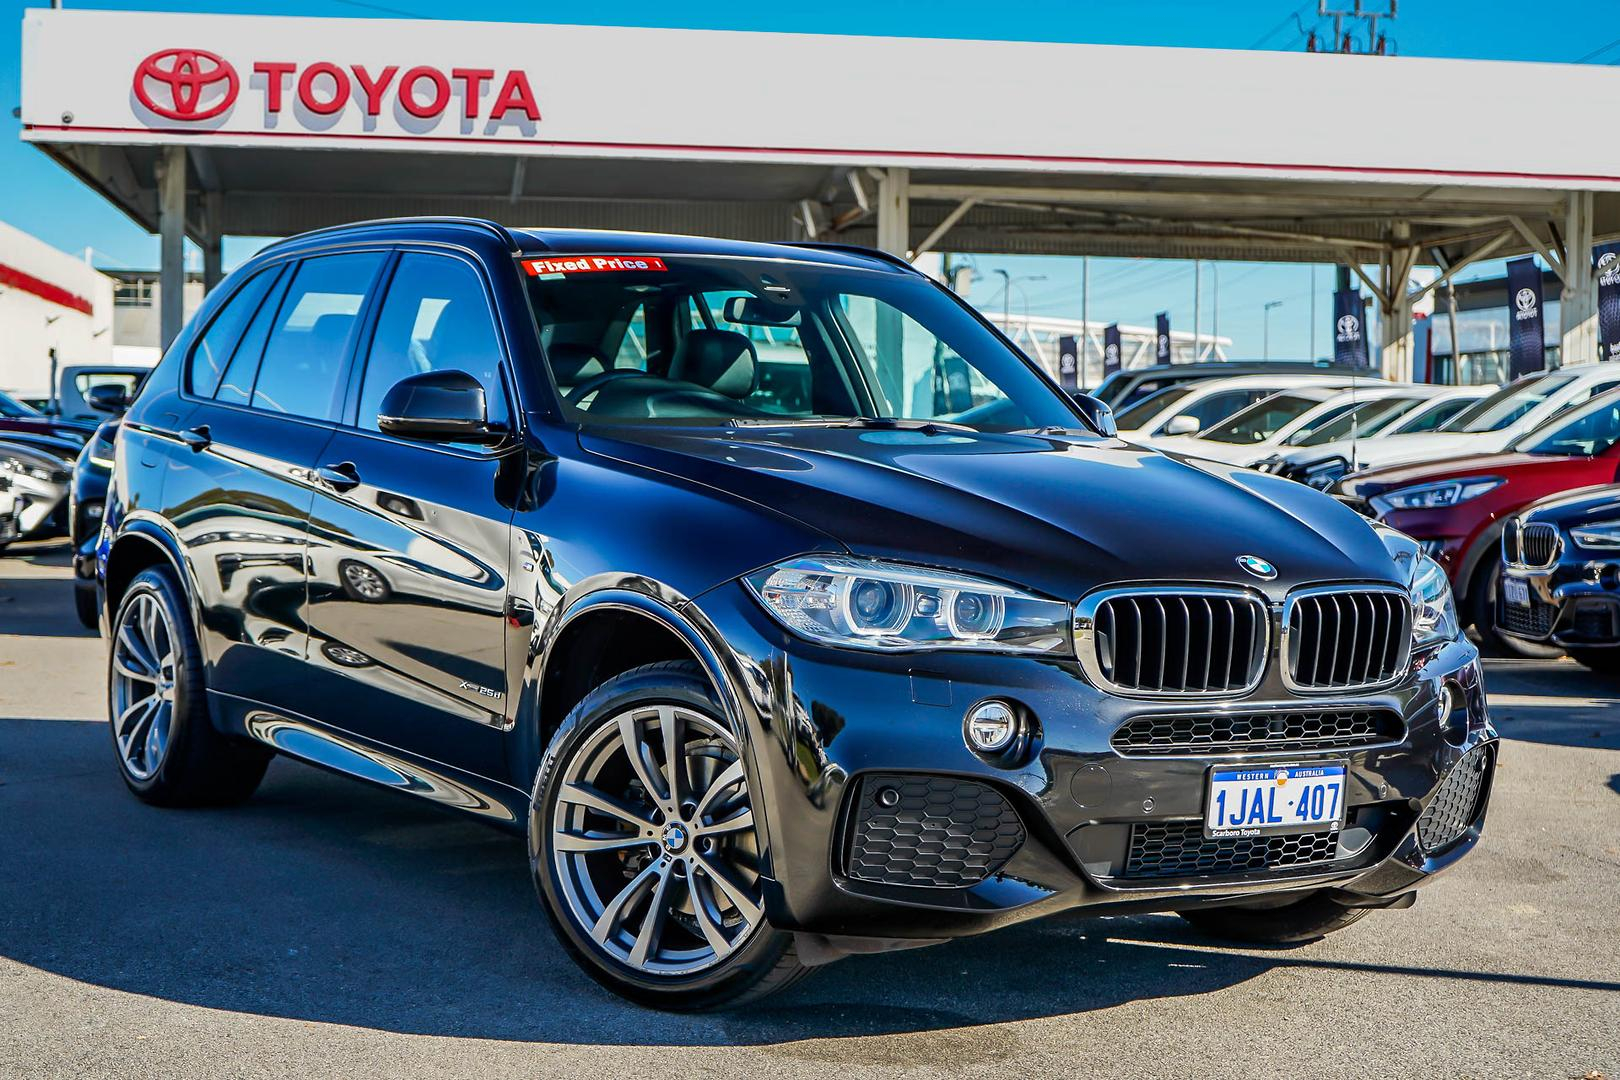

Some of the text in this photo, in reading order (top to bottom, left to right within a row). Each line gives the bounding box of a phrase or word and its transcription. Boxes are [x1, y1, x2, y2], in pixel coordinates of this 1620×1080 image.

[254, 62, 542, 121] TOYOTA
[531, 257, 649, 273] Fixed Price
[1236, 769, 1324, 780] WESTERN AUSTRALIA
[1212, 829, 1261, 837] Scarboro Toyota
